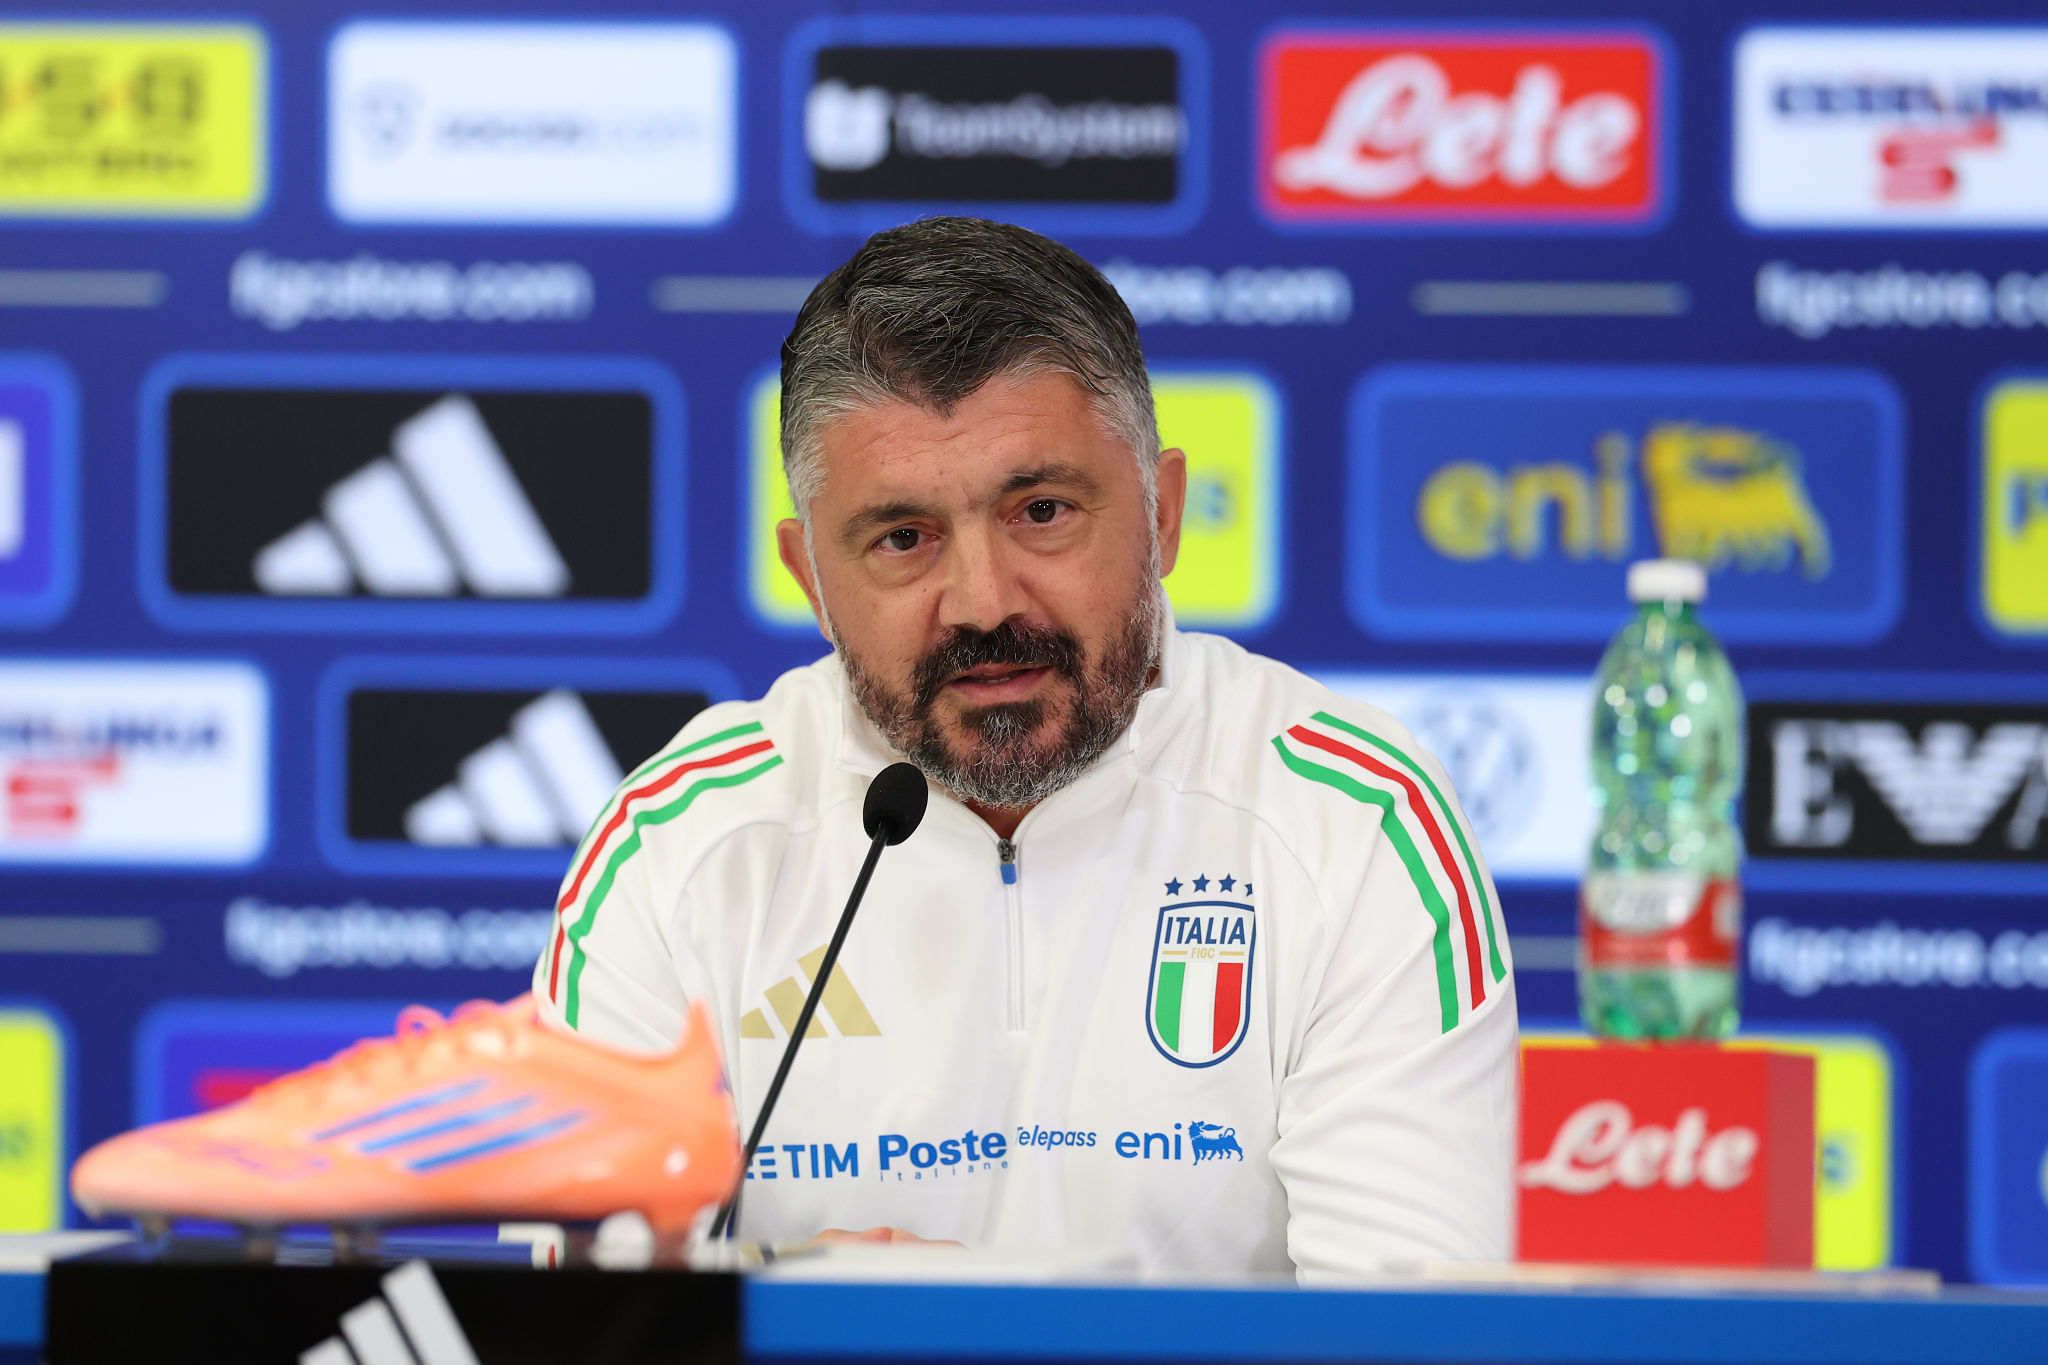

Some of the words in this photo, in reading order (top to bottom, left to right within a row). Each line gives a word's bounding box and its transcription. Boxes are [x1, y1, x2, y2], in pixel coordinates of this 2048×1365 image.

[1275, 54, 1641, 198] Lete
[1417, 431, 1632, 561] eni
[1164, 916, 1246, 944] ITALIA
[1191, 947, 1215, 959] FIGC
[878, 1129, 1007, 1171] Poste
[1115, 1123, 1182, 1160] eni
[1518, 1100, 1758, 1196] Lete
[782, 1142, 859, 1179] TIM
[880, 1160, 1009, 1182] italiane
